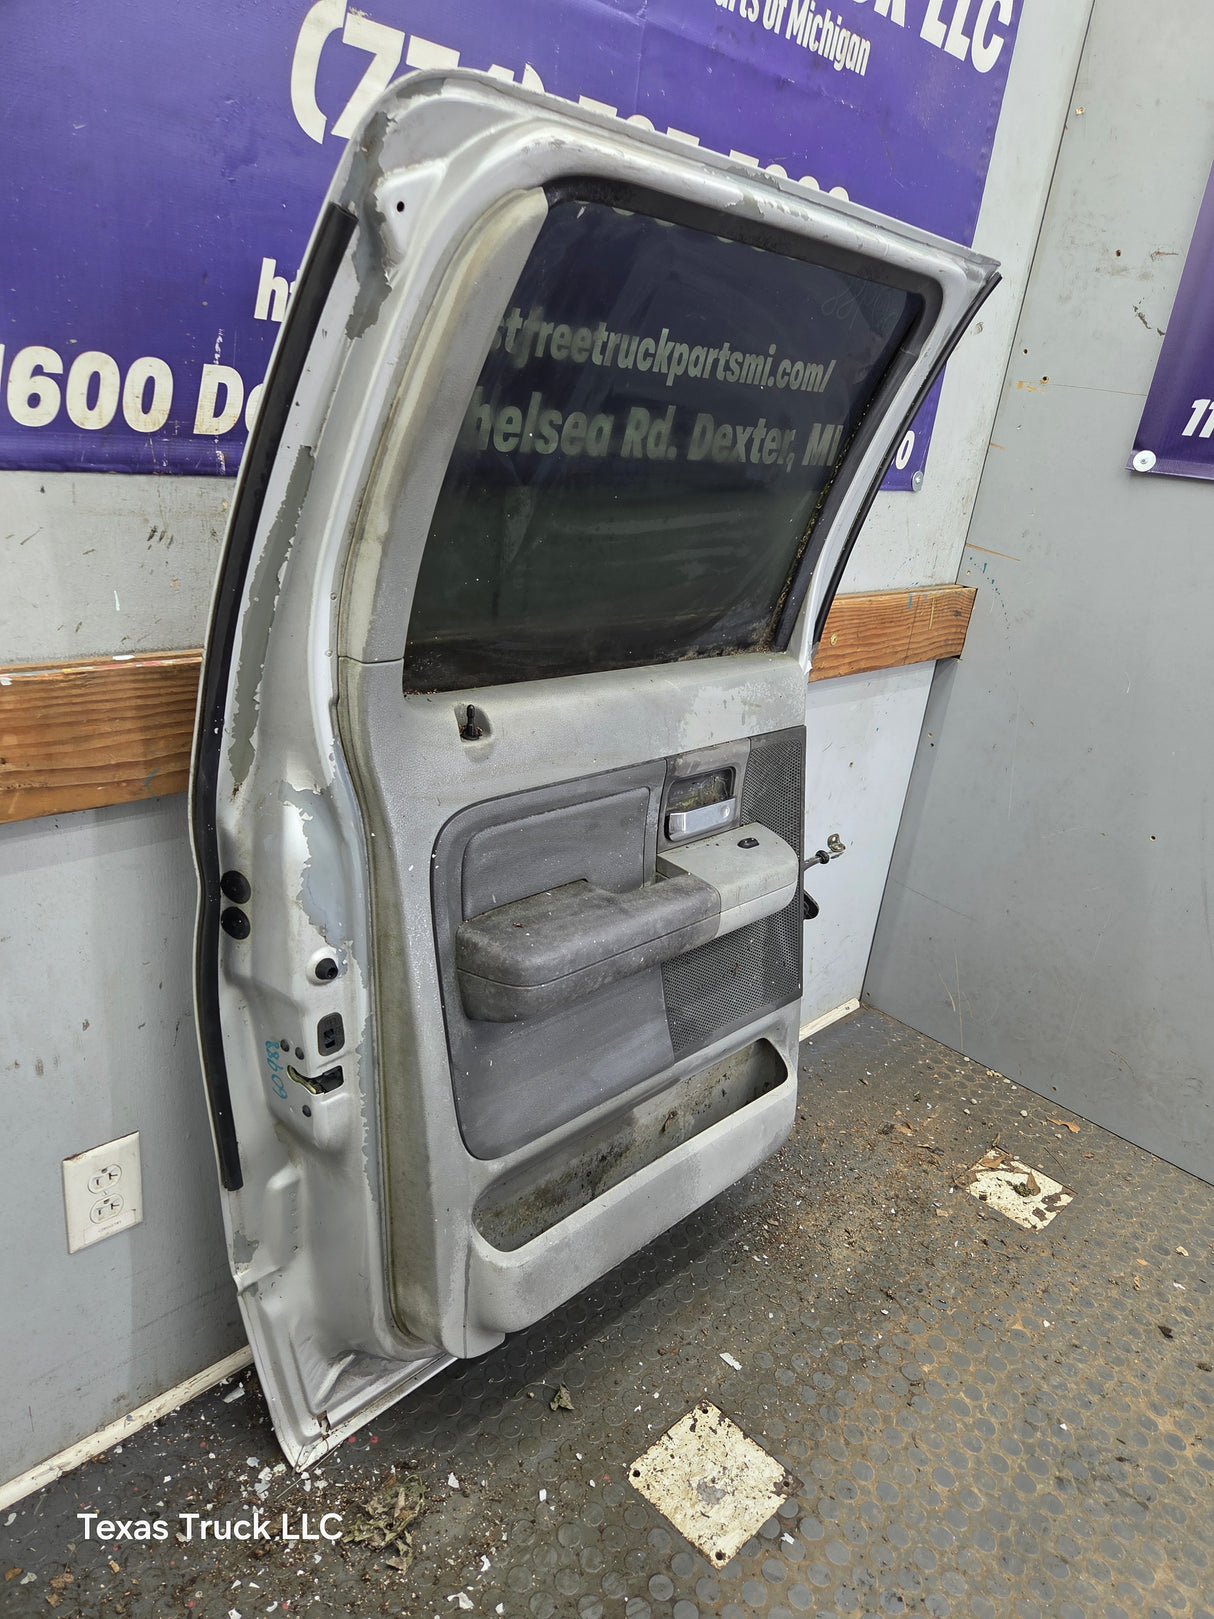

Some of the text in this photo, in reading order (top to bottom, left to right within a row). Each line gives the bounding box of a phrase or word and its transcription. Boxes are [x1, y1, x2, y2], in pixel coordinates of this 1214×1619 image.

[785, 0, 871, 76] Michigan
[920, 0, 1011, 73] LLC
[495, 306, 837, 393] tfreetruckpartsmi.com/
[0, 343, 174, 433] 600
[620, 404, 677, 460] Rd.
[687, 412, 797, 473] Dexter,
[801, 422, 844, 466] MI
